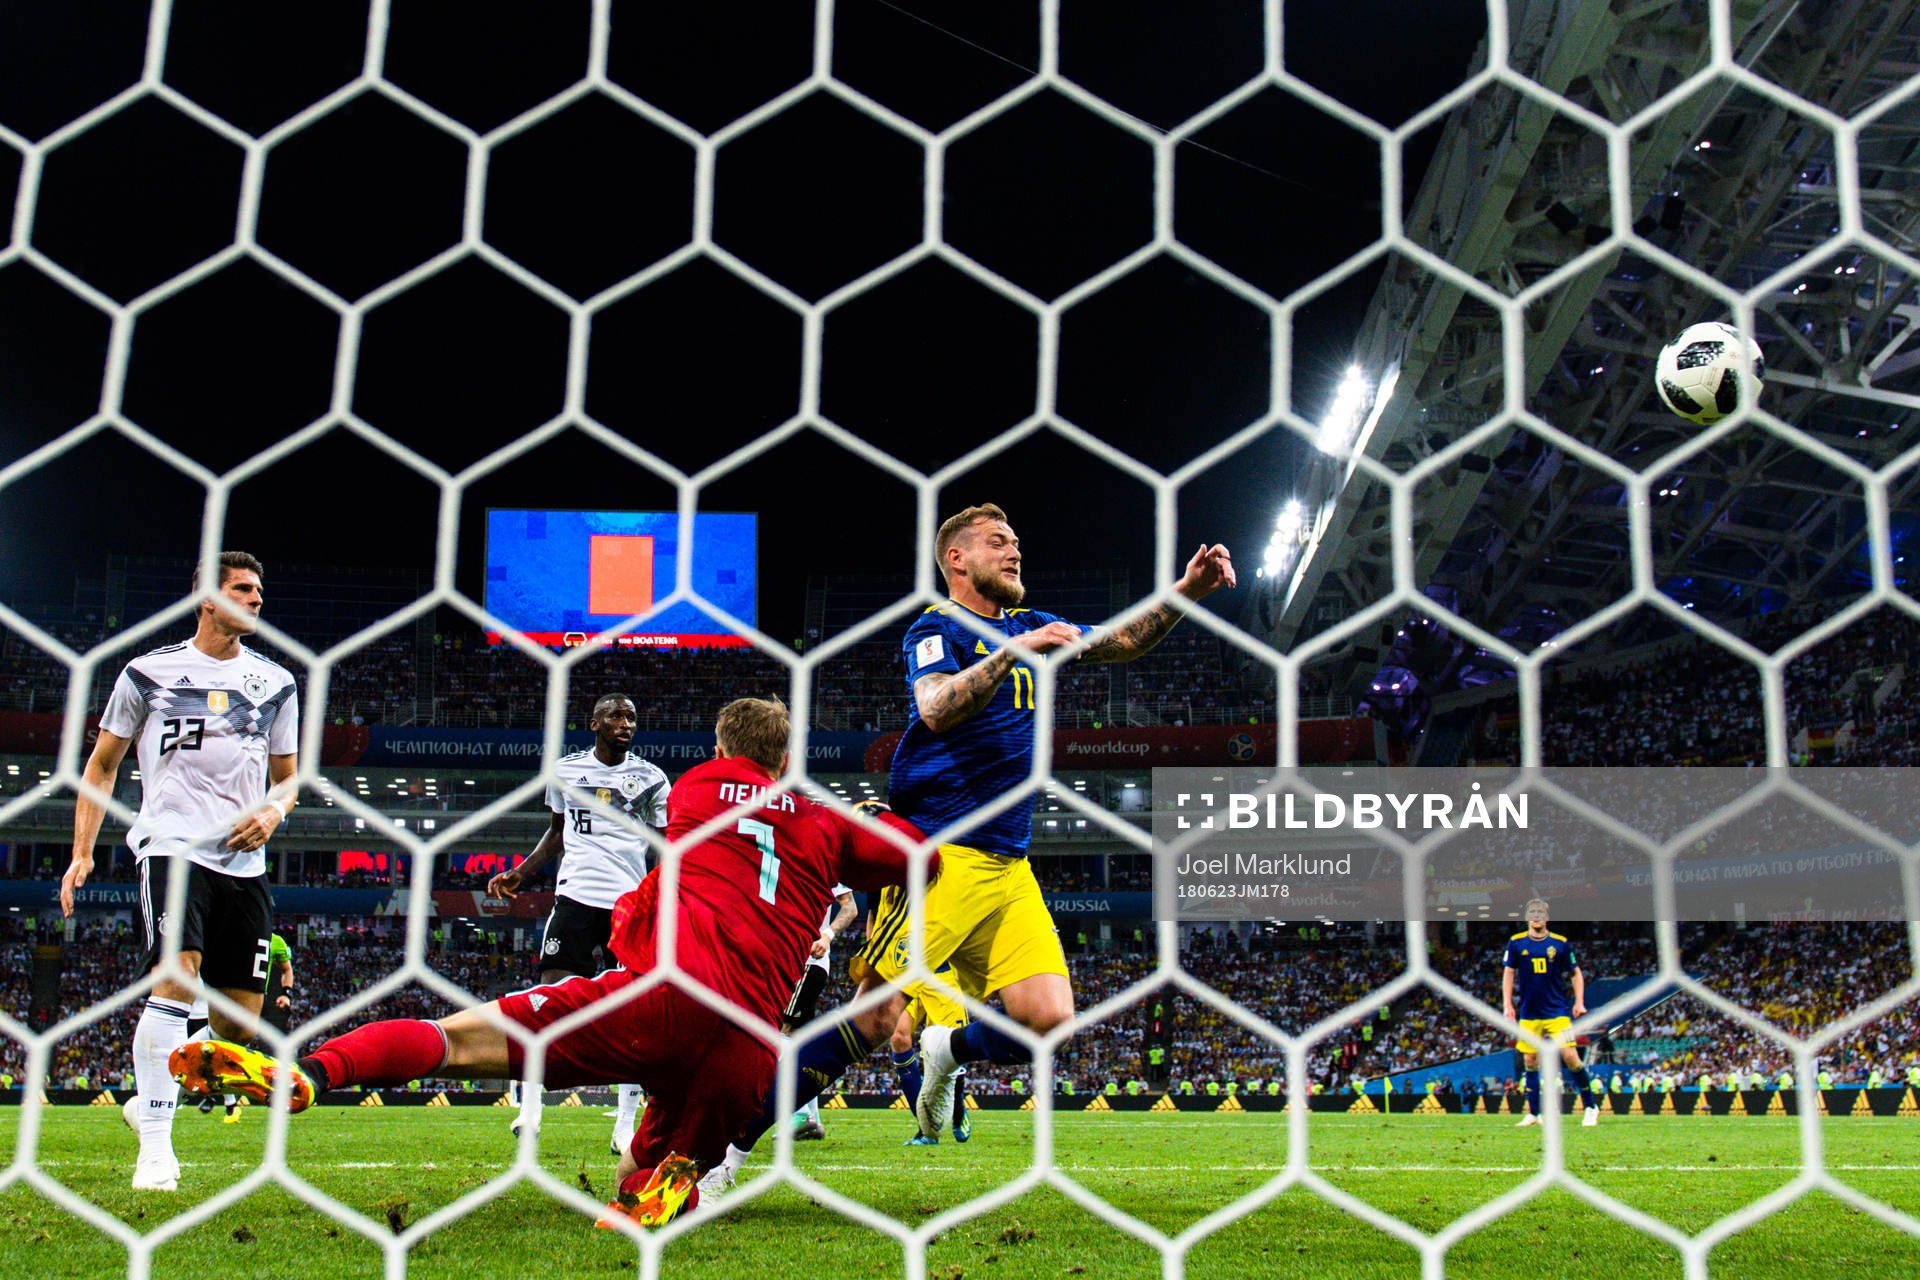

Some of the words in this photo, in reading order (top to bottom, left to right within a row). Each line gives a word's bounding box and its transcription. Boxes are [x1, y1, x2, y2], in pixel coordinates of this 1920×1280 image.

[633, 636, 678, 645] BOATENG
[1010, 668, 1035, 709] 11
[160, 718, 206, 756] 23
[385, 740, 495, 756] ЧЕМПИОНАТ
[671, 744, 707, 758] FIFA
[1065, 741, 1150, 757] #worldcup
[719, 783, 795, 812] NEUER
[569, 808, 592, 834] 16
[738, 818, 781, 906] 1
[1723, 862, 1769, 880] МИРА
[1772, 860, 1793, 875] ПО
[1796, 852, 1863, 872] ФУТБОЛУ
[89, 889, 122, 904] FIFA
[1054, 899, 1111, 912] RUSSIA
[1531, 957, 1547, 974] 10
[150, 1099, 174, 1109] DFB
